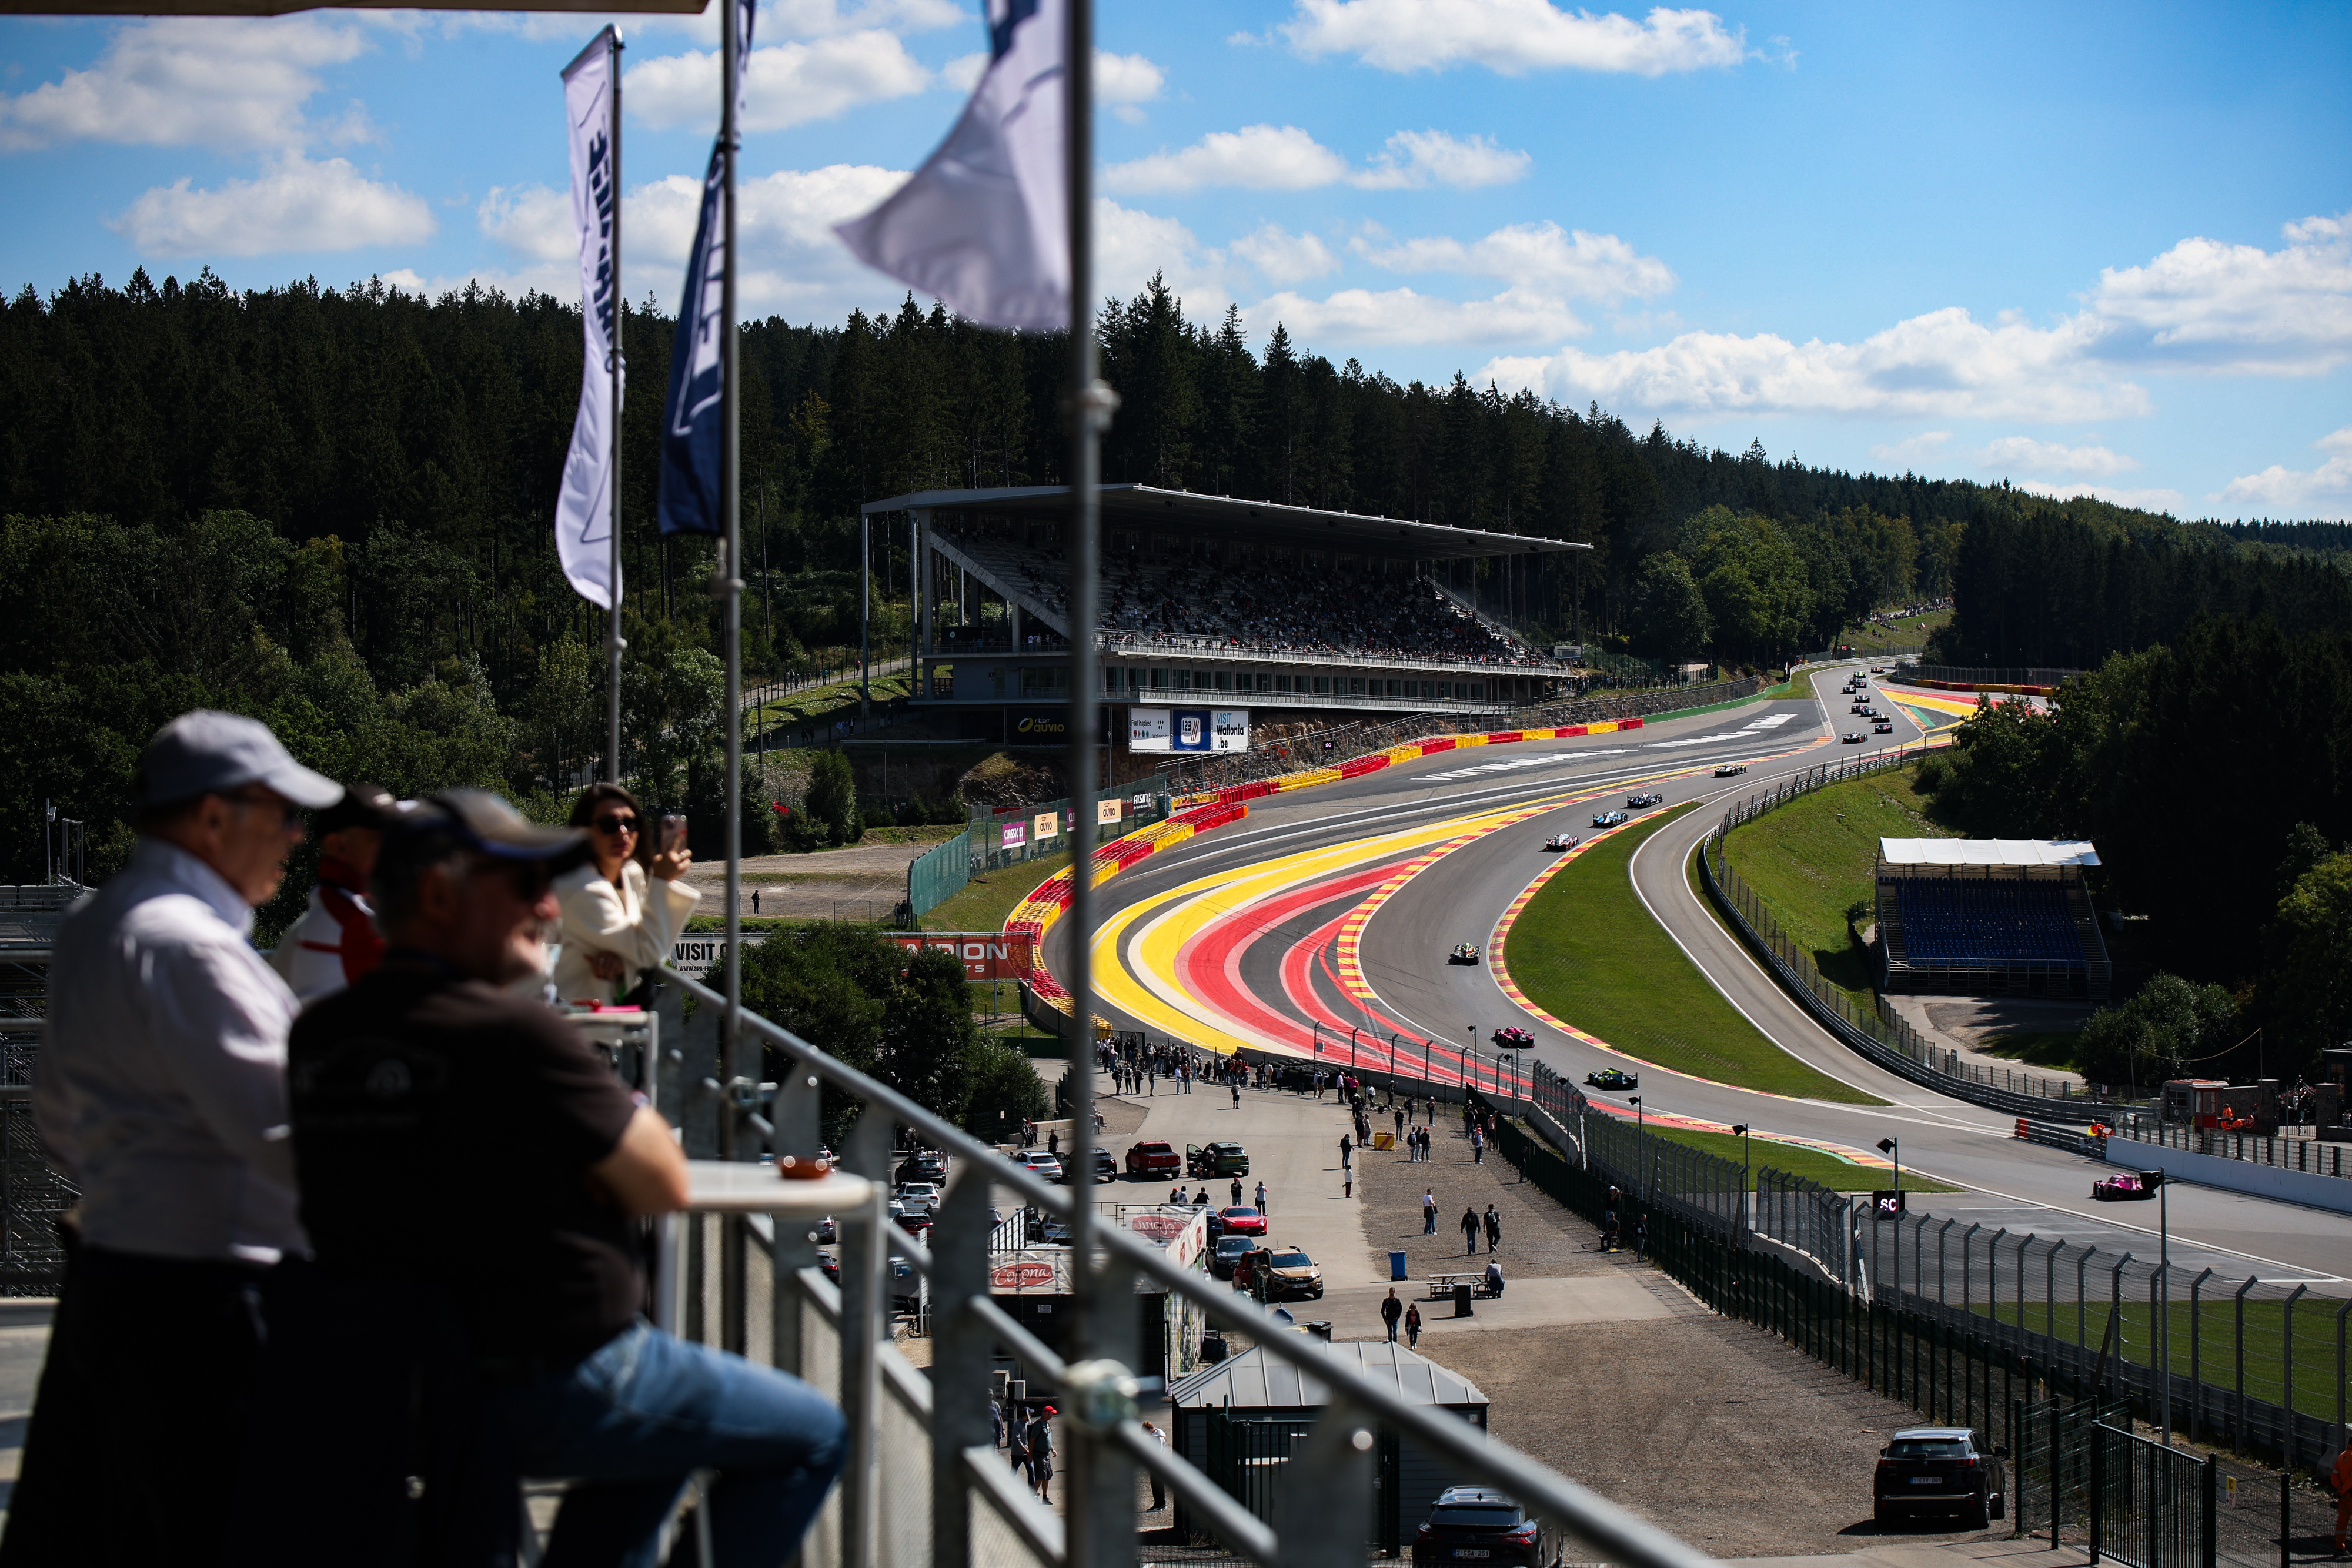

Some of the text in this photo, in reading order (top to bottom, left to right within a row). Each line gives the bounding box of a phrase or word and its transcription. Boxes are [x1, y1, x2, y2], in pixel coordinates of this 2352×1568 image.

[1217, 713, 1232, 724] VISIT
[1182, 720, 1191, 731] 123
[1216, 723, 1244, 735] Wallonia
[1133, 793, 1148, 804] AISIN
[1004, 827, 1018, 840] CLASSIC
[676, 942, 715, 961] VISIT
[1880, 1198, 1898, 1211] SC
[995, 1266, 1050, 1286] Colona
